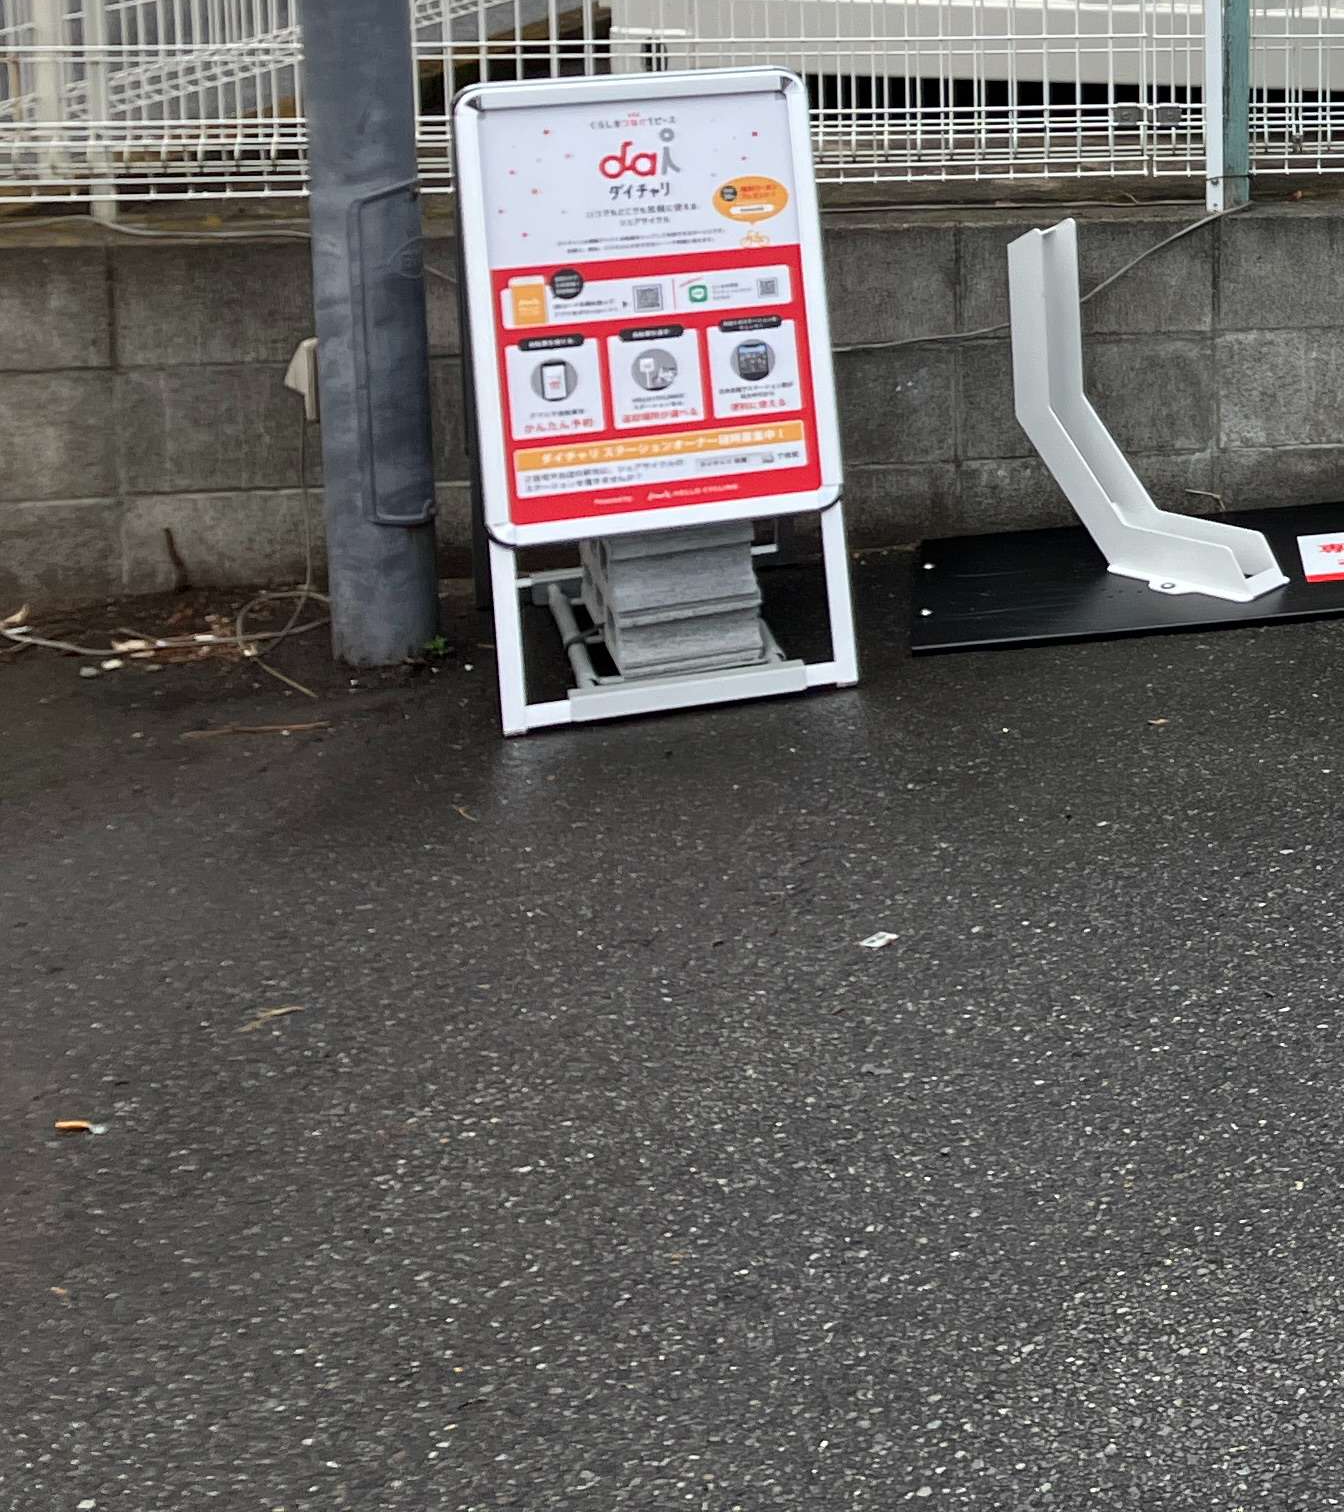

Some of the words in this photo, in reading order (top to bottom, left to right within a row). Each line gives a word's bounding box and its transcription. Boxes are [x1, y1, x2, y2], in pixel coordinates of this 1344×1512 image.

[608, 181, 671, 201] ダイチャリ
